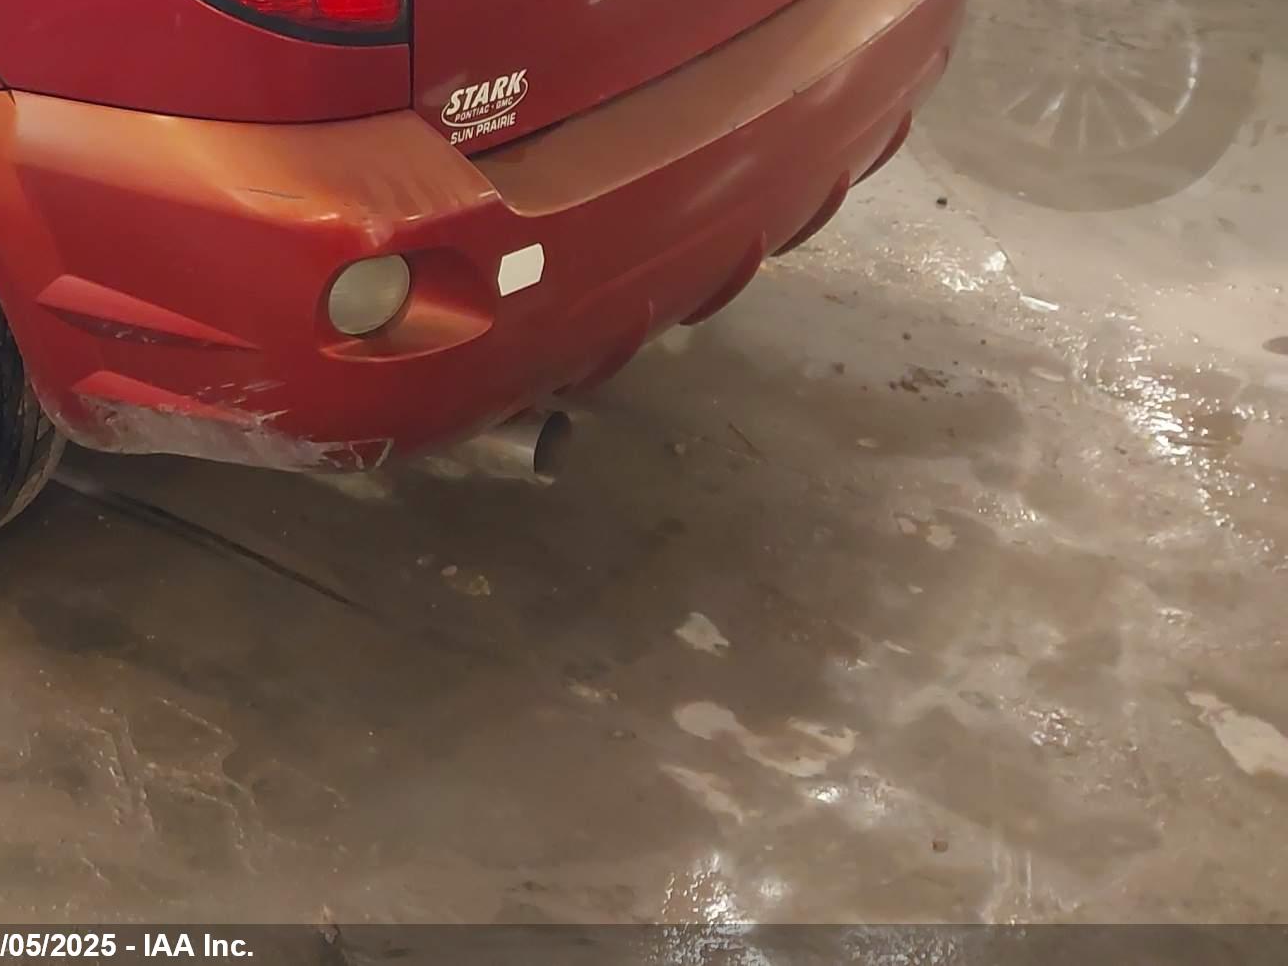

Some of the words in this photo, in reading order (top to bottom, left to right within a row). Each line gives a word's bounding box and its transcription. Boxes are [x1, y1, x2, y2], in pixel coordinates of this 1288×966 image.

[446, 69, 527, 116] STARK
[454, 104, 490, 123] PONTIAC
[496, 97, 514, 110] GMC
[450, 127, 475, 145] SUN
[476, 112, 517, 137] PRAIRIE
